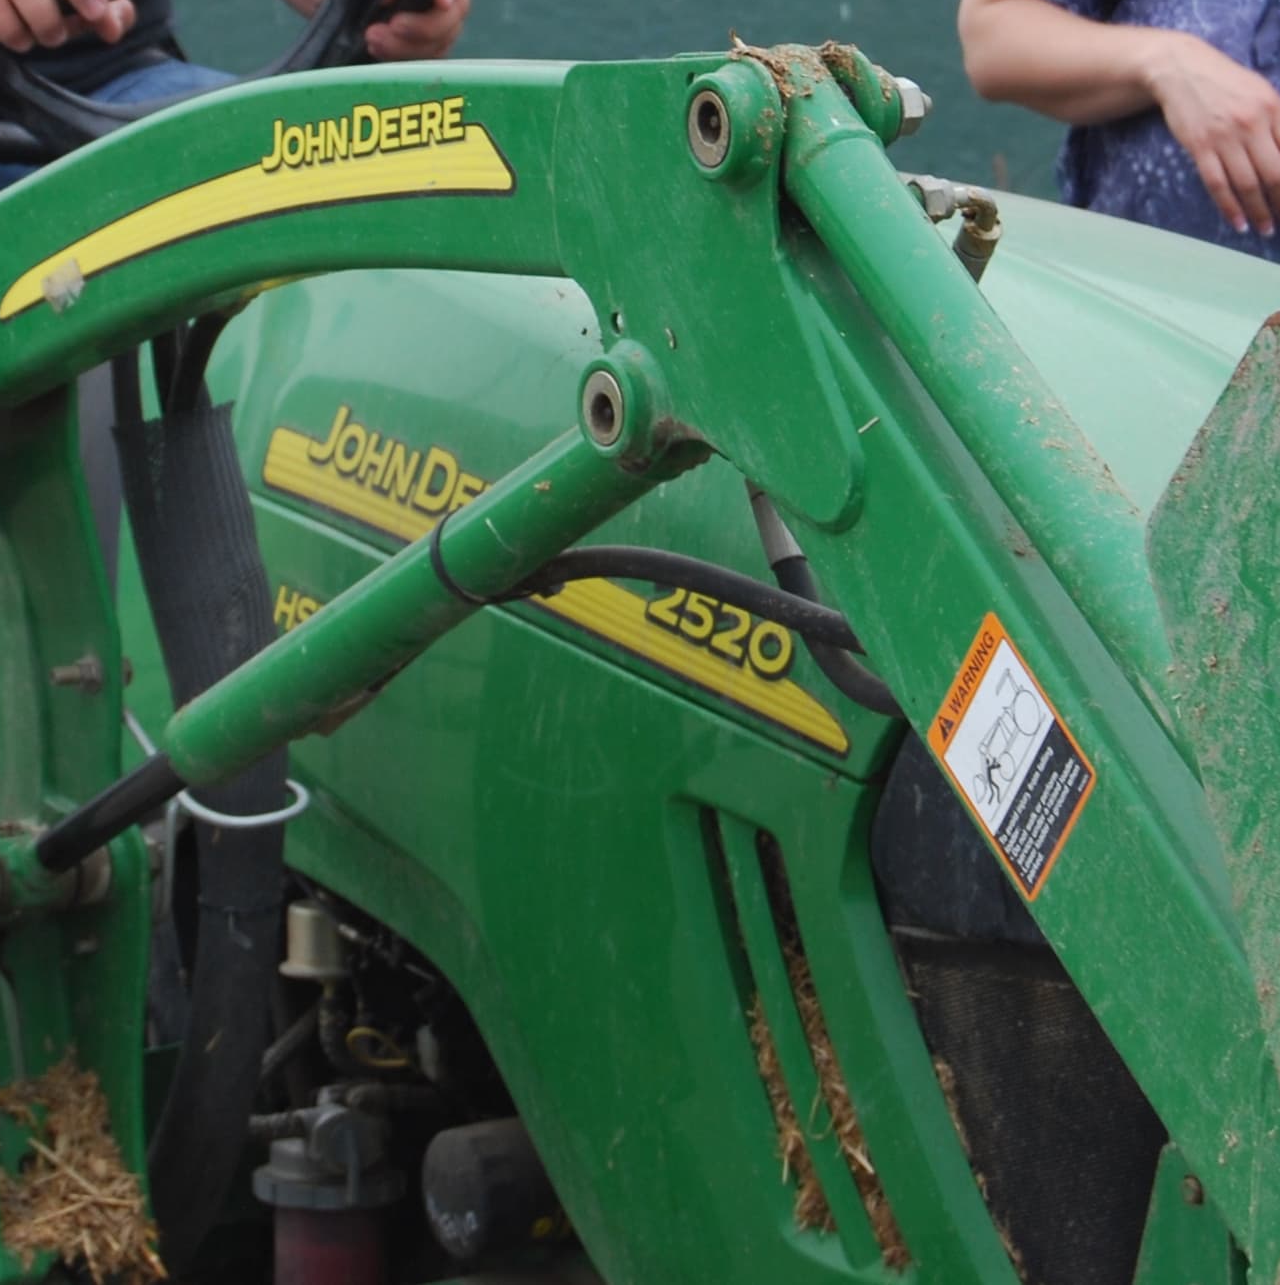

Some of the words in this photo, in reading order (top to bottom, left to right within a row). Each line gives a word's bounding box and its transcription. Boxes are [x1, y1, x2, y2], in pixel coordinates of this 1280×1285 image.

[261, 117, 349, 172] JOHN
[351, 95, 465, 156] DEERE
[646, 586, 794, 680] 2520
[947, 627, 995, 718] WARNING
